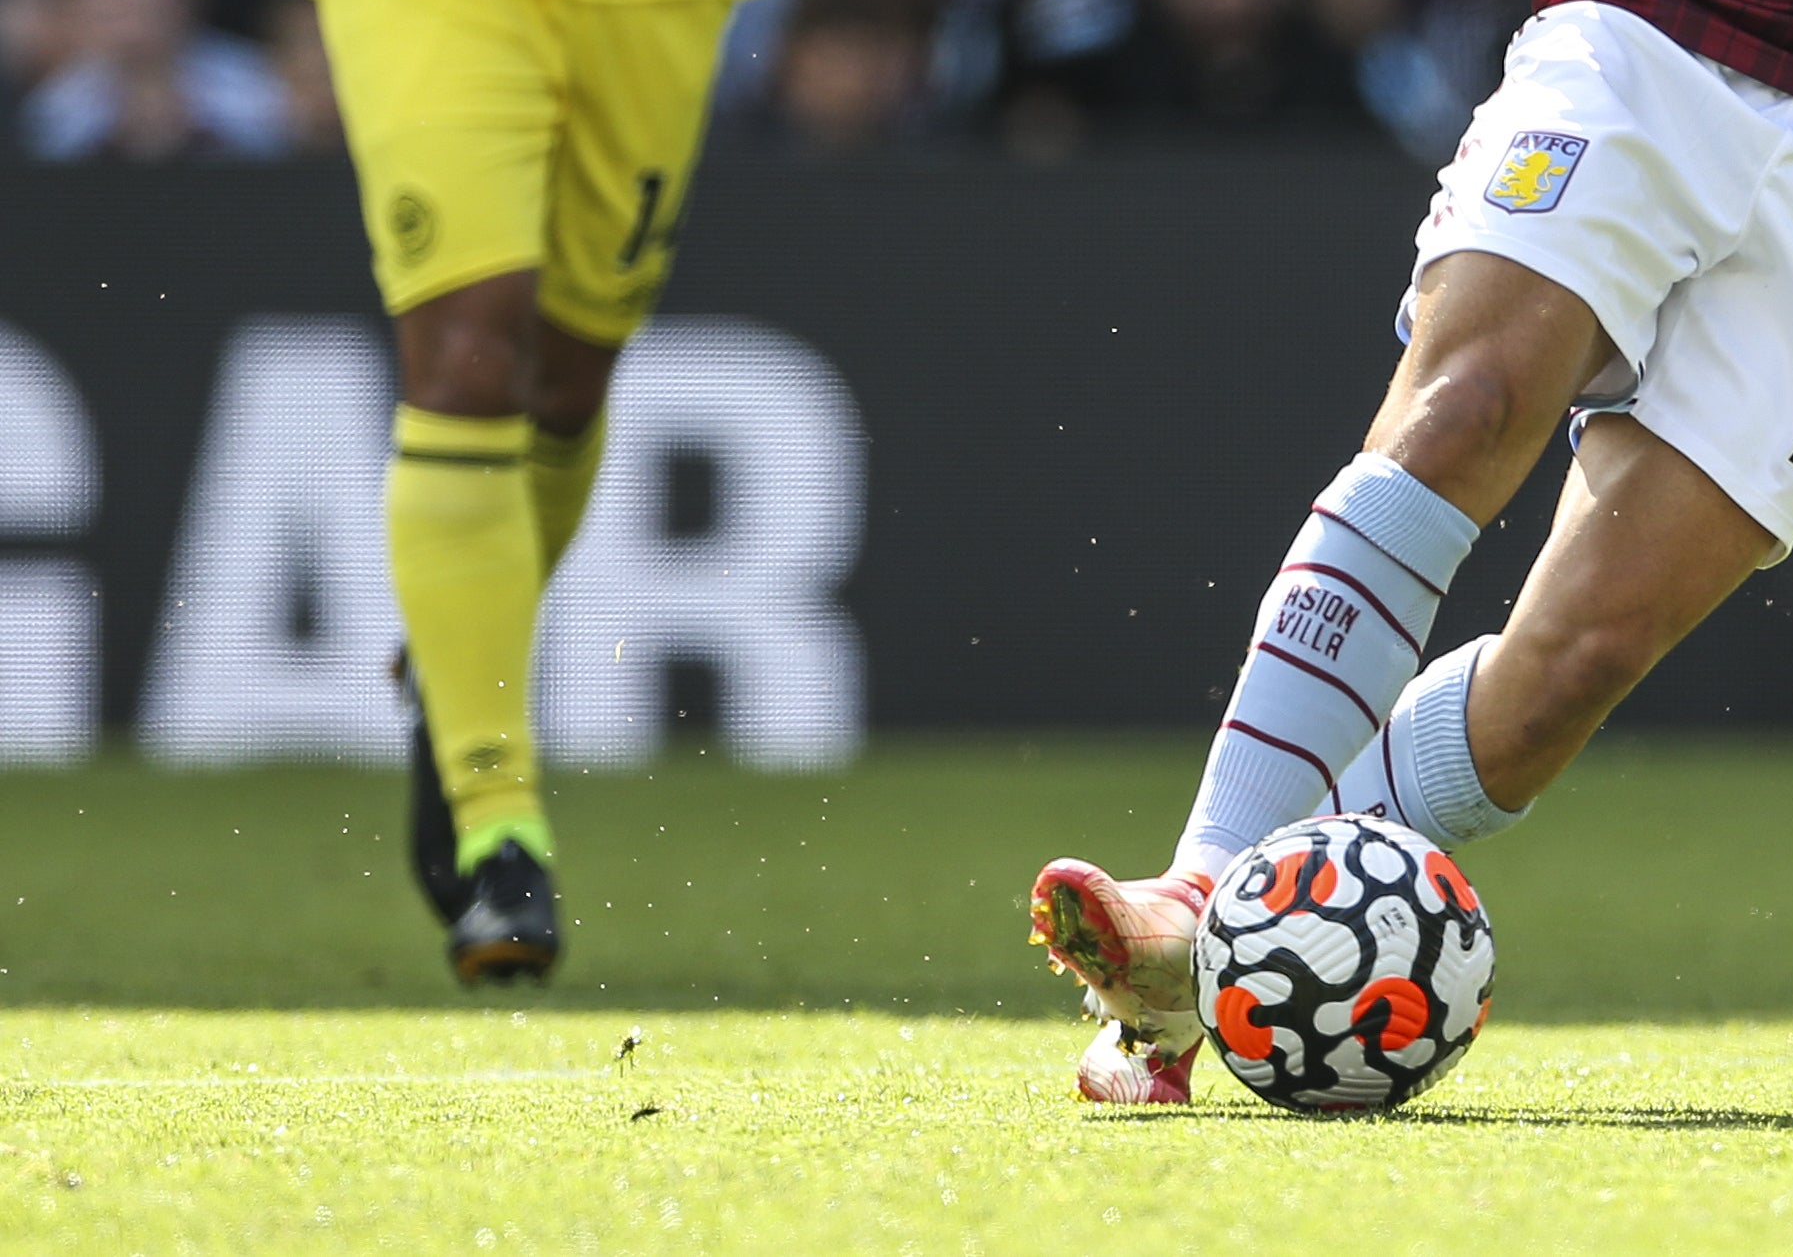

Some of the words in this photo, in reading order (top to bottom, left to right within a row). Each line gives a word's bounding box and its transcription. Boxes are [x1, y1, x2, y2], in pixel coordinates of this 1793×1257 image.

[1511, 134, 1582, 158] AVFC
[1284, 584, 1361, 635] ASTON
[1276, 609, 1345, 662] VILLA
